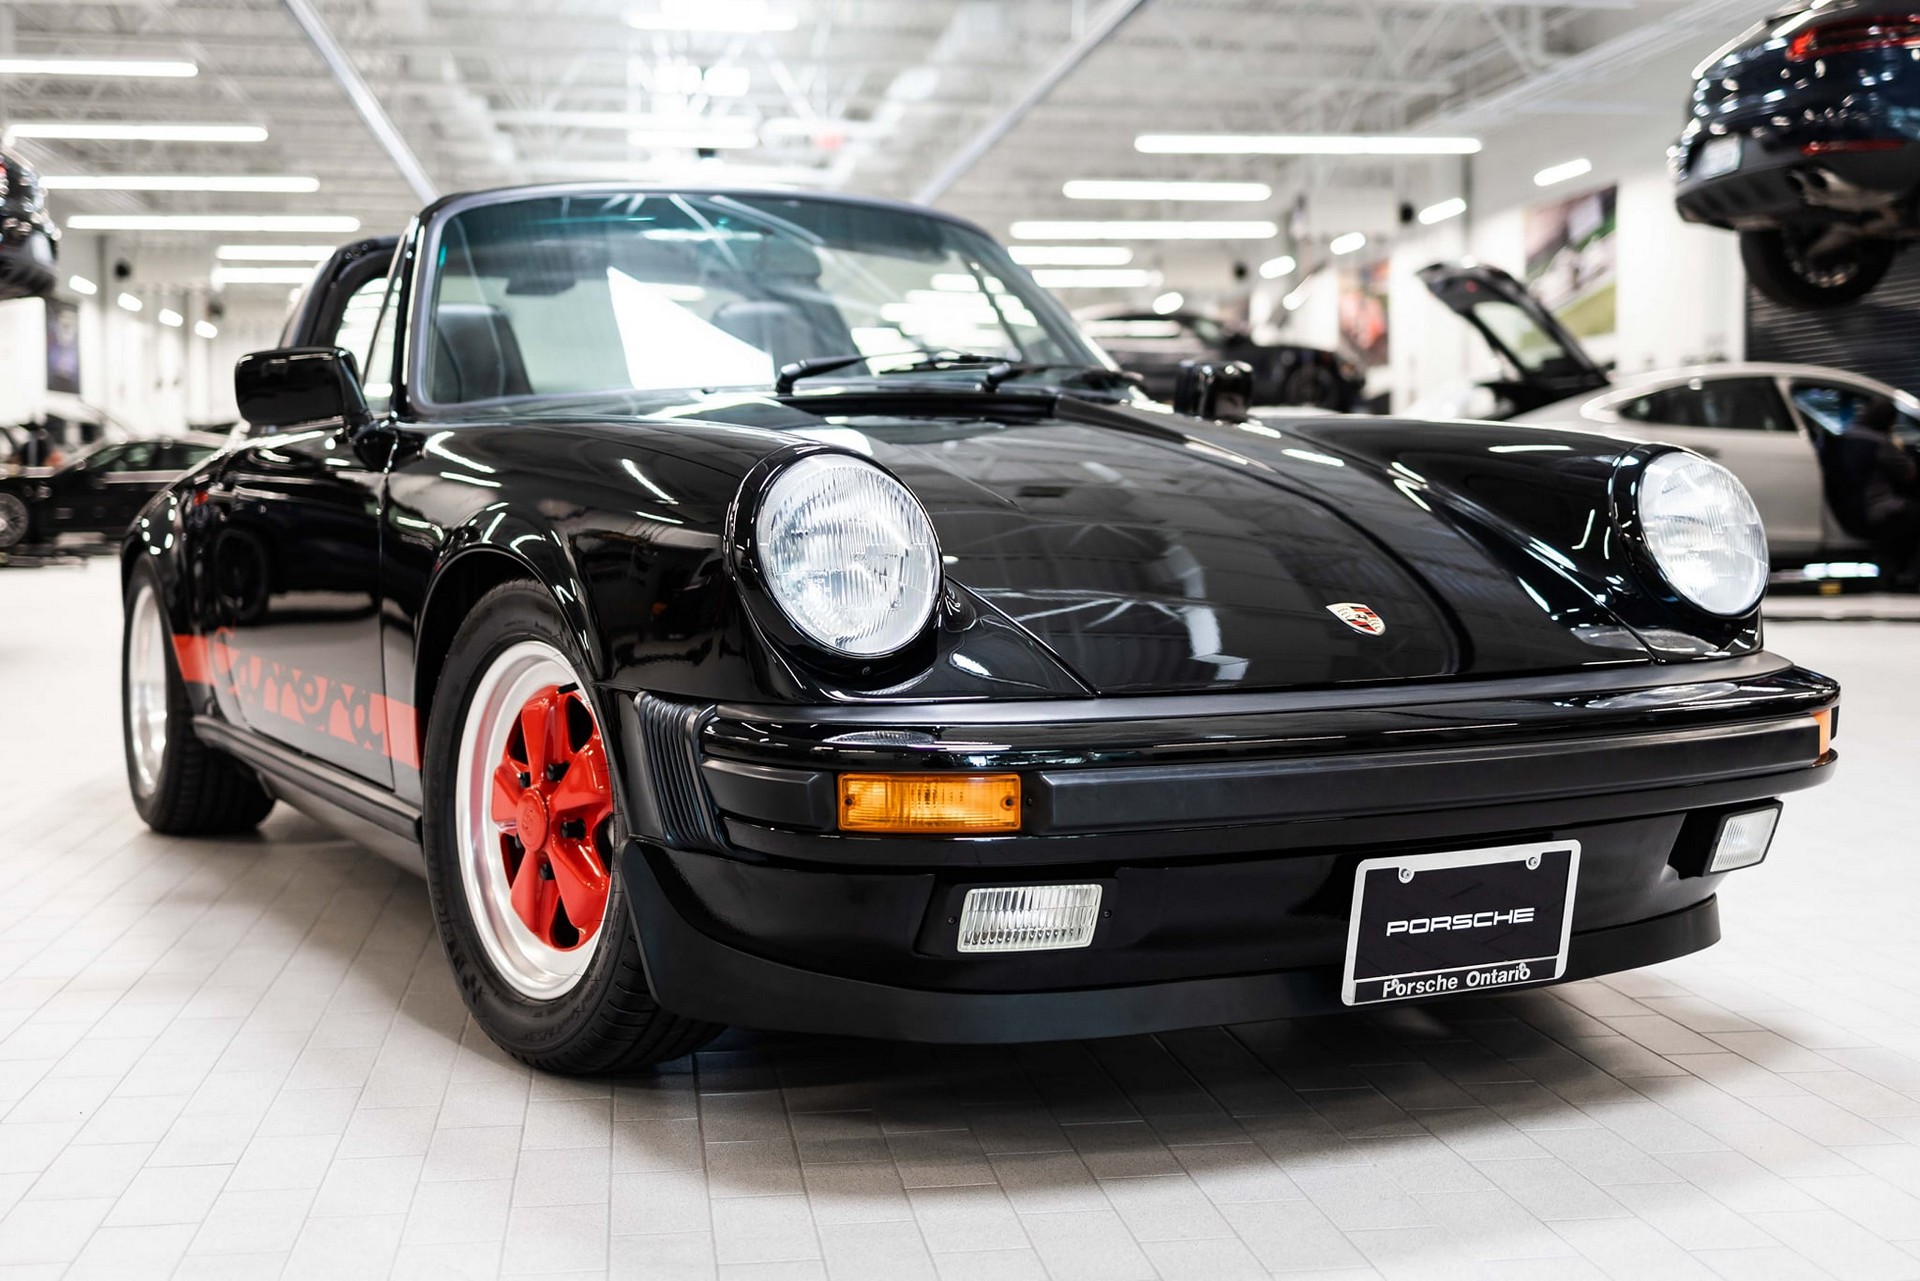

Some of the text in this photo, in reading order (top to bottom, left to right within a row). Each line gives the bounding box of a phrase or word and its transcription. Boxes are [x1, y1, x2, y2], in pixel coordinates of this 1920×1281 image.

[211, 627, 385, 751] Carrera
[1386, 907, 1535, 937] PORSCHE
[1382, 965, 1531, 998] Porsche Ontario
